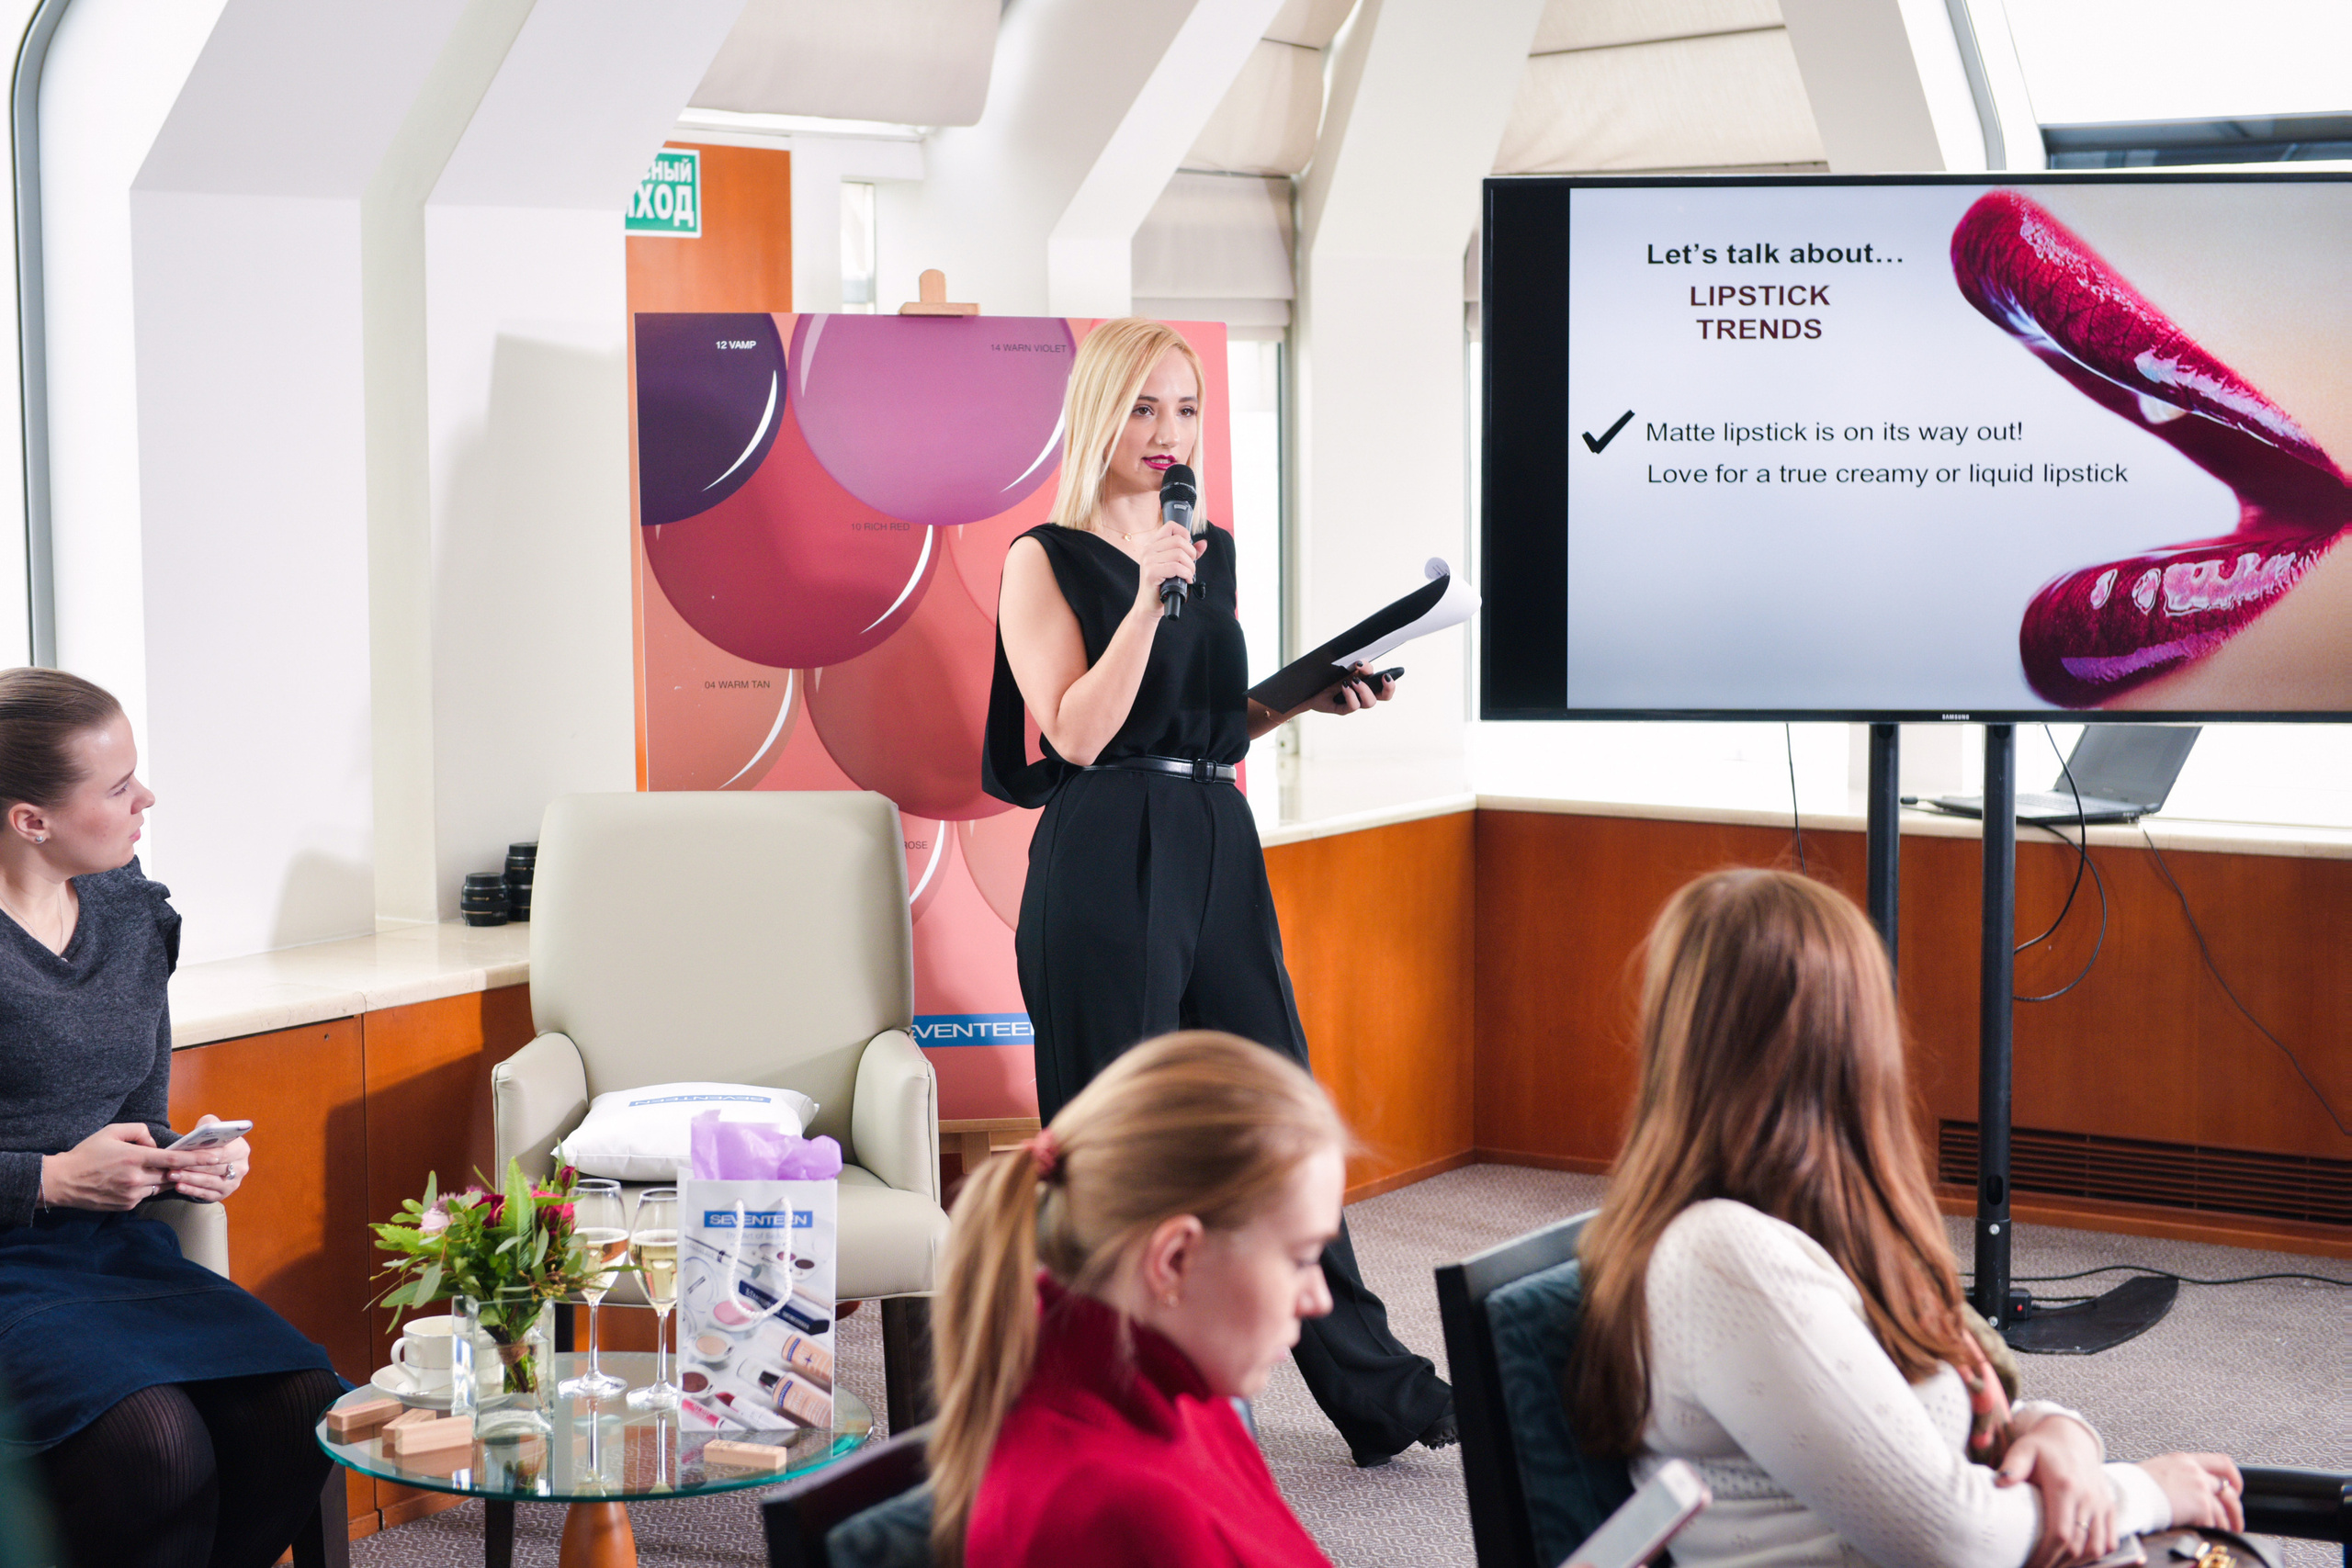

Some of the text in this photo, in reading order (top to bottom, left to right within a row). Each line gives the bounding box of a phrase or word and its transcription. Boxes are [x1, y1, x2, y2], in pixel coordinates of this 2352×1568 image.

[1647, 243, 1718, 265] Let’s
[1725, 242, 1781, 265] talk
[1690, 284, 1831, 307] LIPSTICK
[1695, 318, 1823, 341] TRENDS
[716, 340, 757, 350] 12 VAMP
[990, 344, 1067, 353] 14 WARN VIOLET
[1646, 421, 2023, 447] Matte lipstick is on its way out!
[1647, 462, 2129, 489] Love for a true creamy or liquid lipstick
[851, 522, 910, 531] 10 RICH RED
[704, 680, 771, 689] 04 WARM TAN
[911, 1021, 1035, 1039] VENTEE
